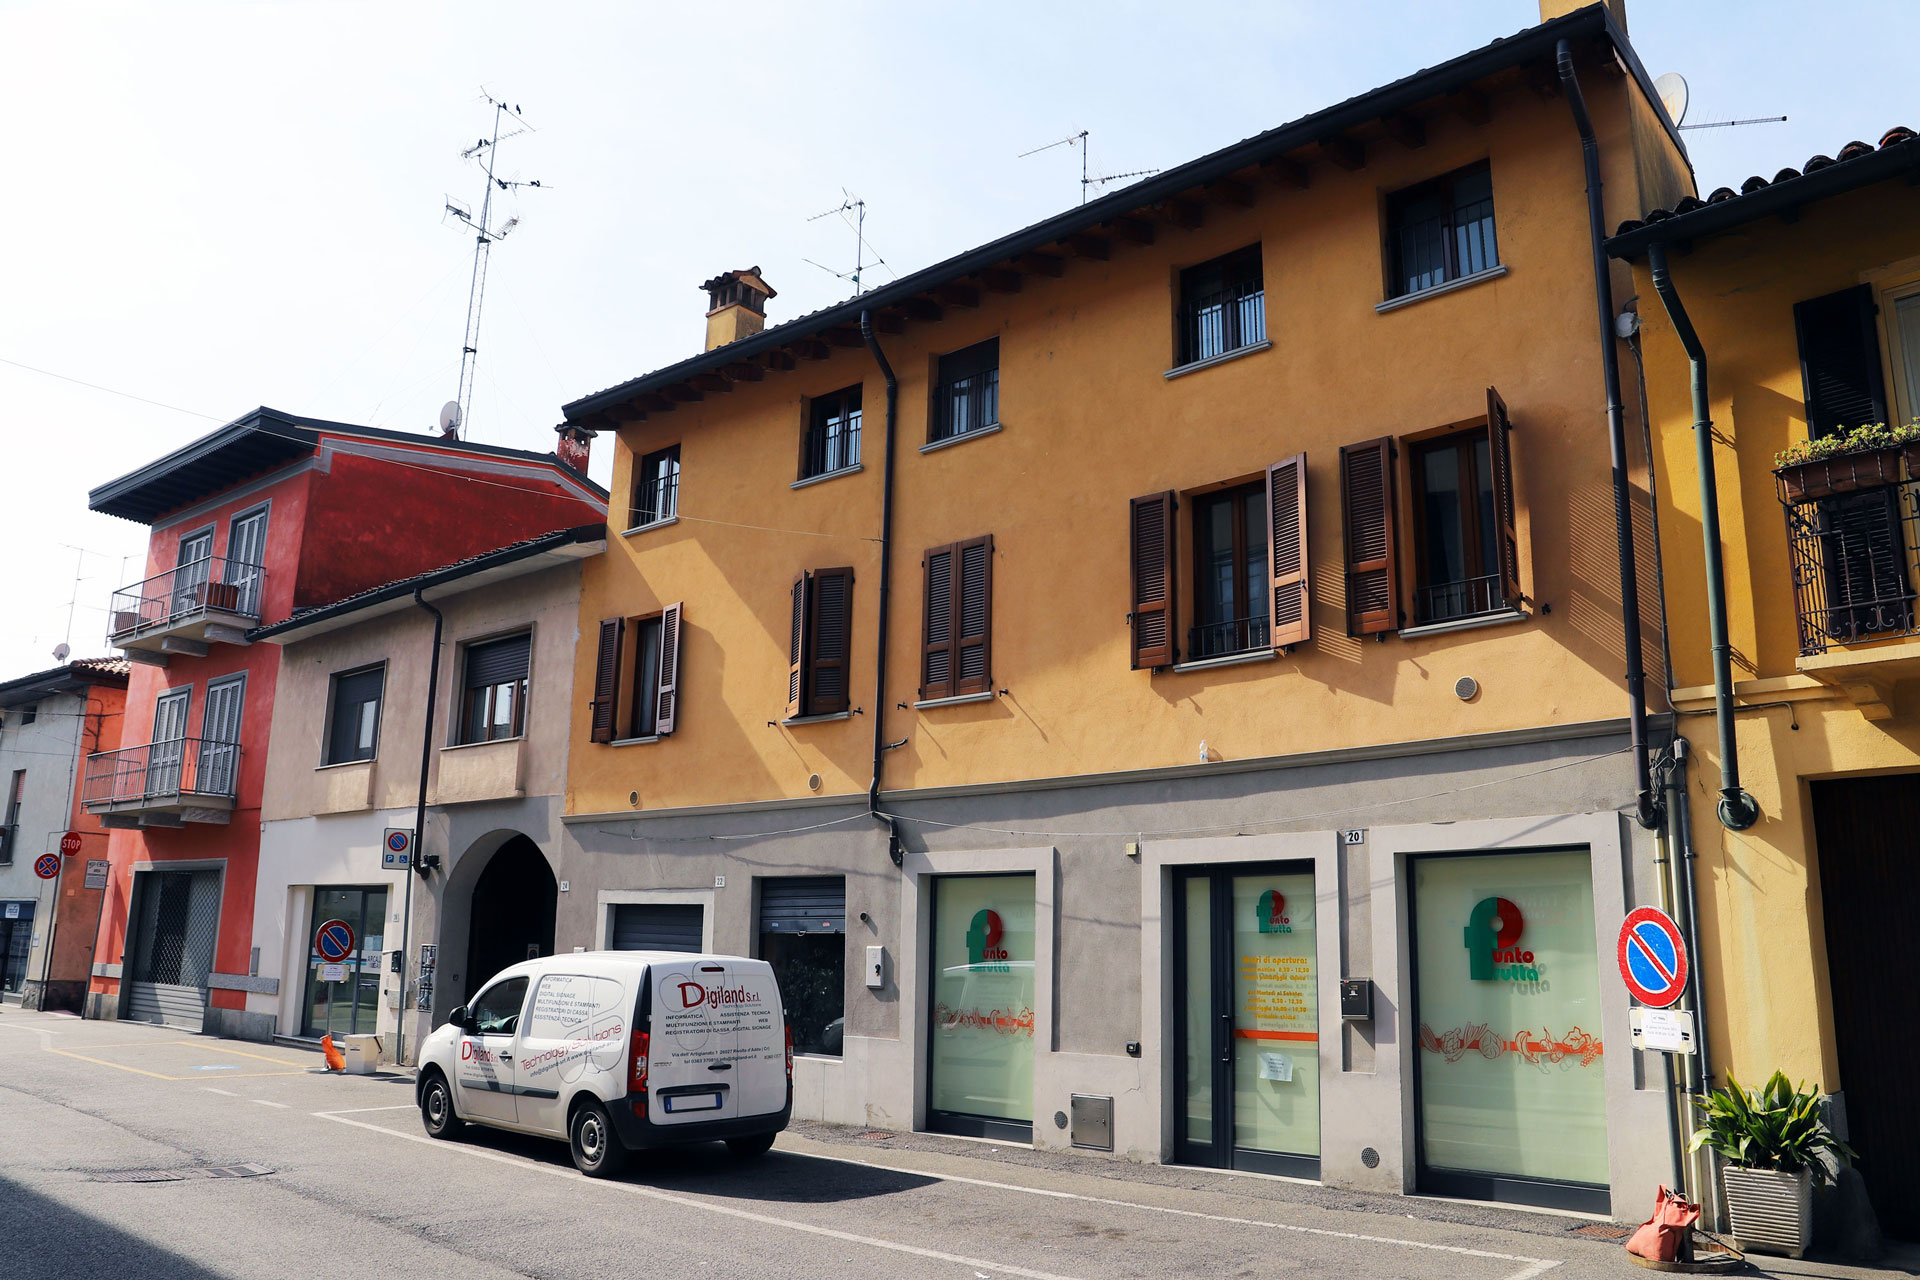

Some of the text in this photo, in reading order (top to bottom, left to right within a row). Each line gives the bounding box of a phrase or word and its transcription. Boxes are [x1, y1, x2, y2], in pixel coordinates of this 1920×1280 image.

[1349, 832, 1359, 841] 20
[62, 839, 80, 849] STOP
[1264, 956, 1271, 964] di
[1272, 957, 1308, 965] apertura:
[677, 982, 745, 1009] Digiland
[536, 1006, 566, 1014] REGISTRATORI
[534, 1014, 560, 1022] ASSISTENZA
[521, 1024, 622, 1071] Technology Solutions
[462, 1041, 491, 1064] Digiland
